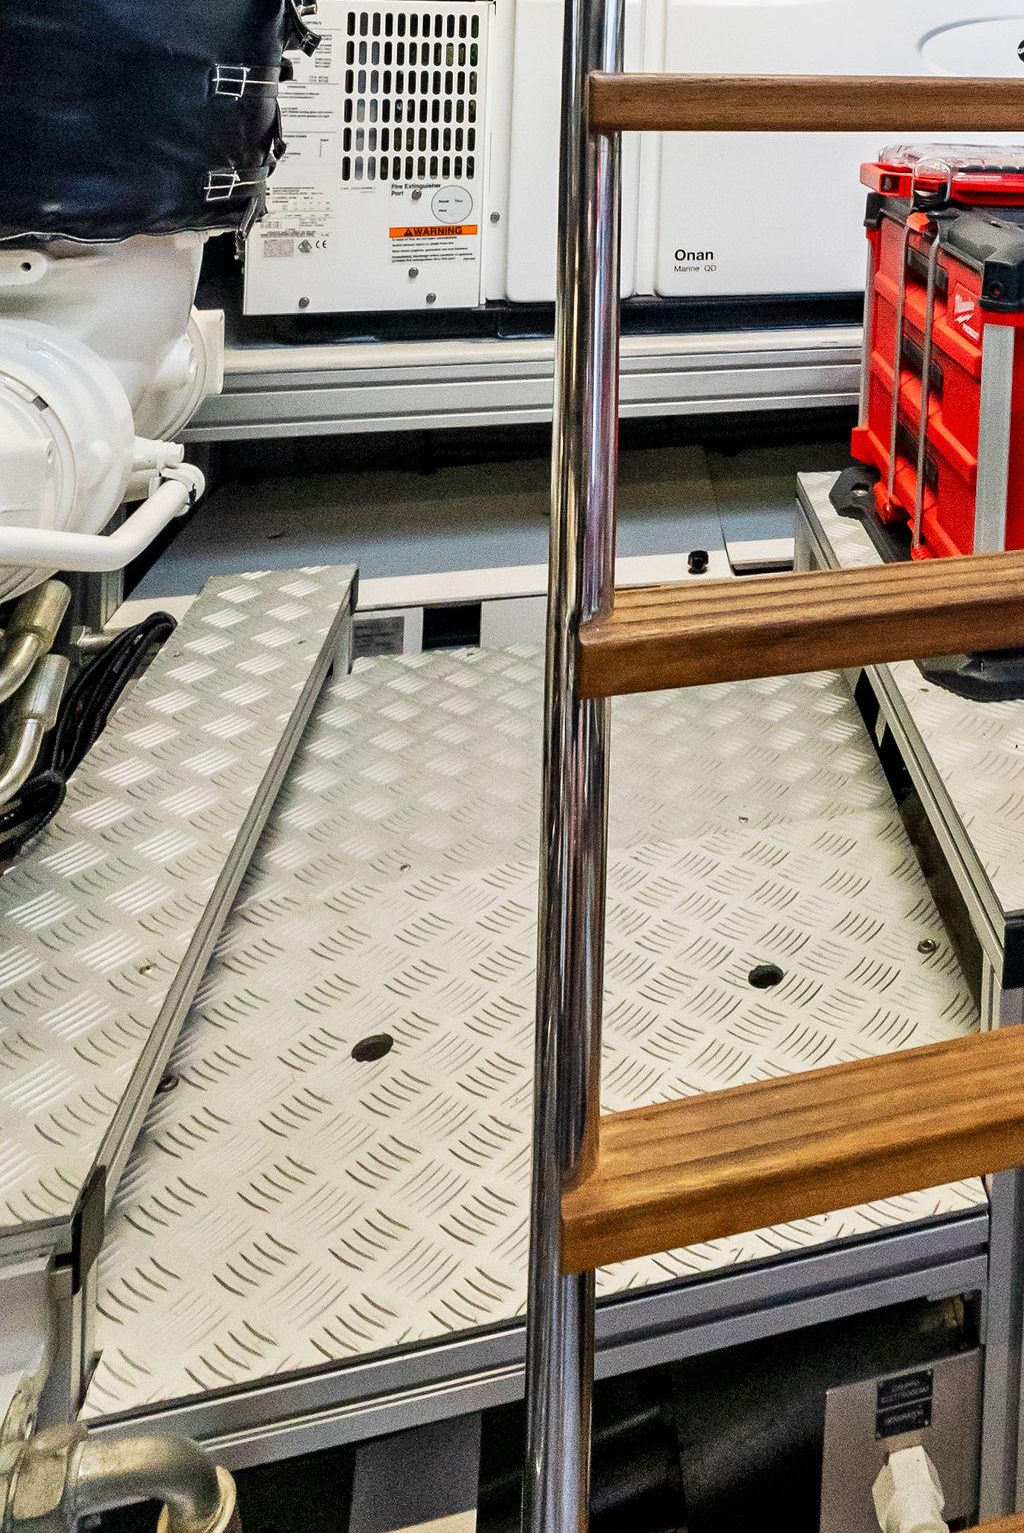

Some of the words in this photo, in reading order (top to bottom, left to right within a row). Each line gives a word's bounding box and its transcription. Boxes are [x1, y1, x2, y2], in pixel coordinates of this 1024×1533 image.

[404, 182, 441, 190] Extinguisher
[412, 225, 463, 237] WARNING
[674, 249, 714, 262] Onan
[673, 265, 700, 273] Marine
